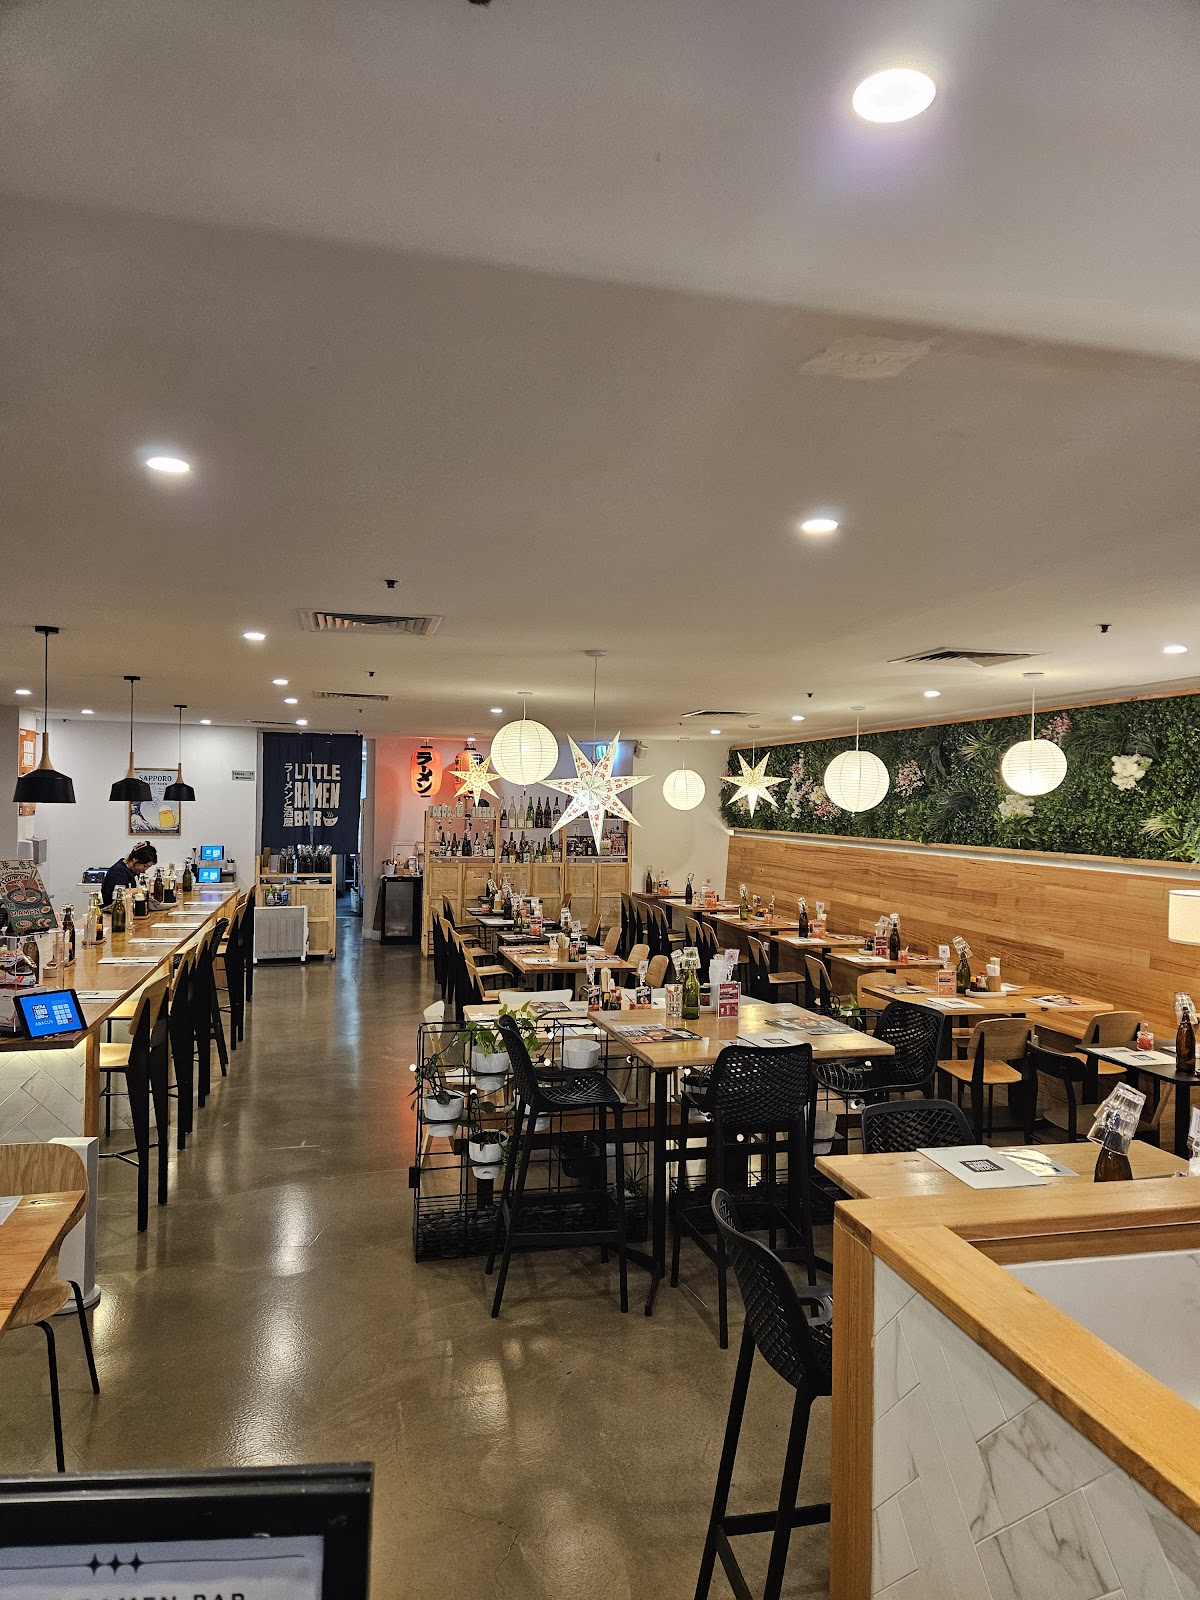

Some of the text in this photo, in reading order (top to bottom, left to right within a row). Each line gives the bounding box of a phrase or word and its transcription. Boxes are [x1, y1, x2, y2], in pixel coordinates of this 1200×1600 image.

[294, 763, 341, 780] LITTLE
[416, 752, 433, 794] ラーメン
[294, 782, 341, 808] RAMEN
[294, 811, 322, 827] BAR
